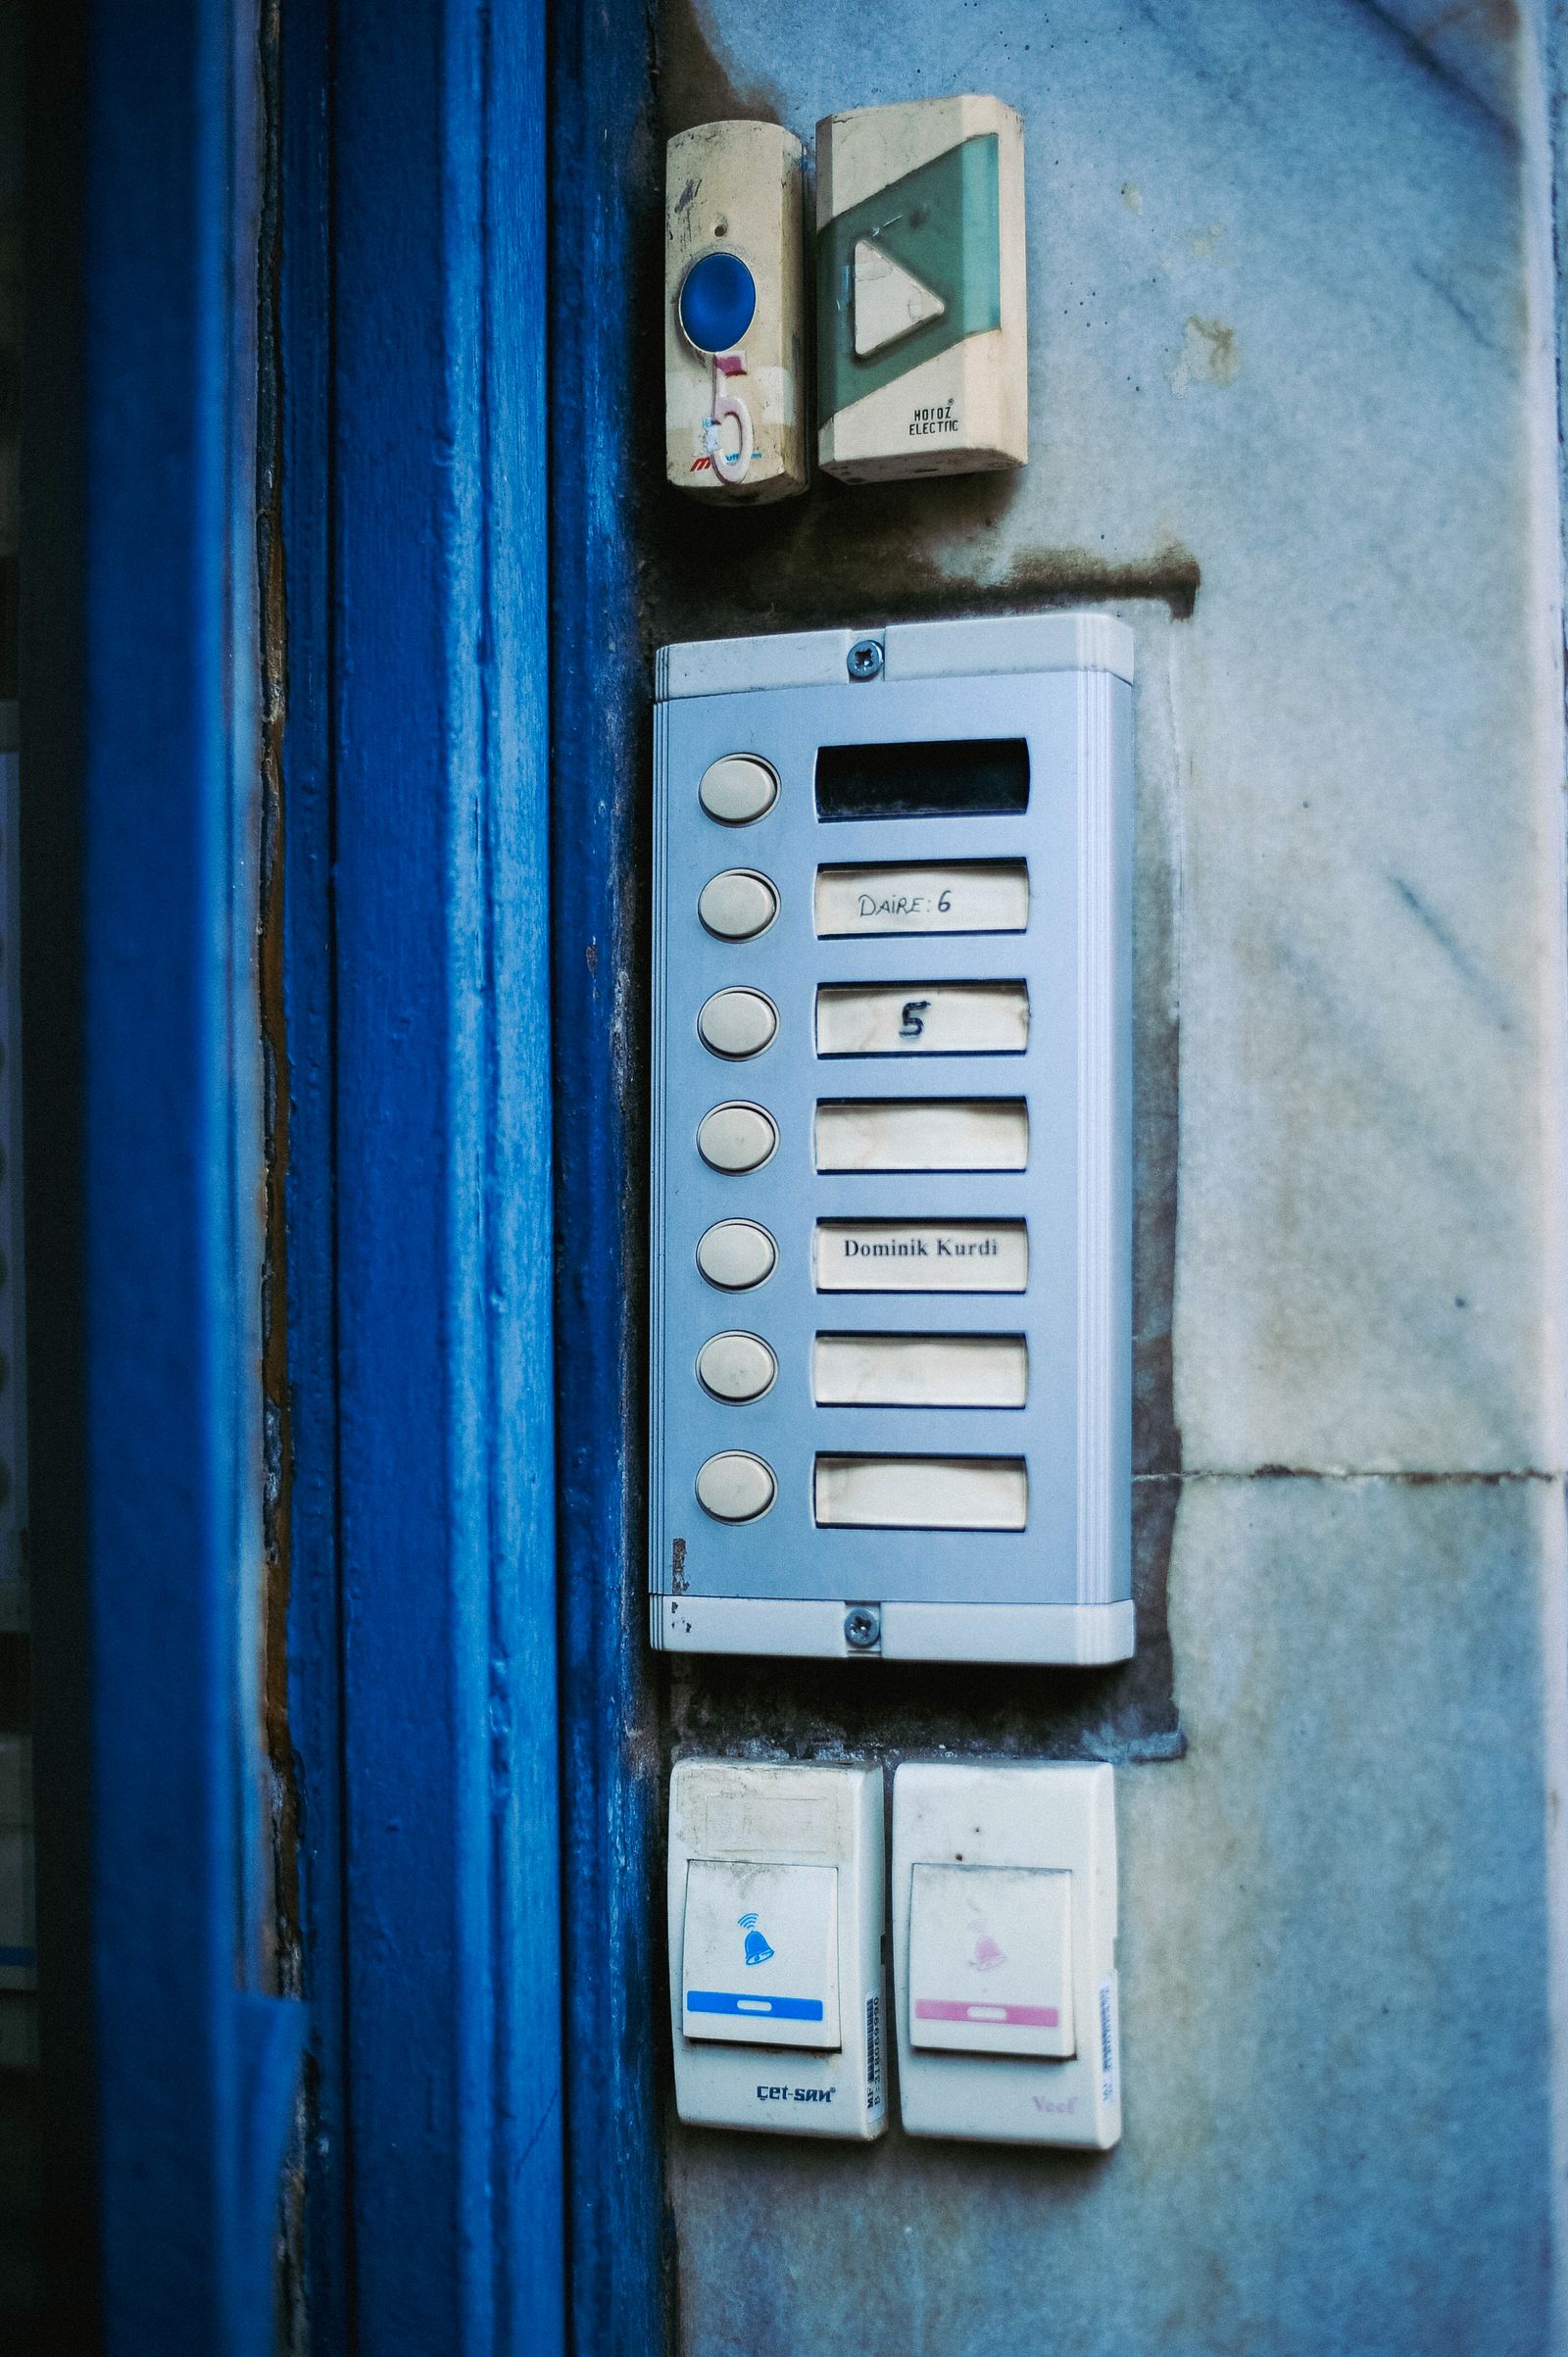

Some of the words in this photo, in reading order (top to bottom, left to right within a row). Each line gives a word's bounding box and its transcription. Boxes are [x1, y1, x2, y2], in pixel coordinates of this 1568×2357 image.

[937, 889, 952, 913] 6
[899, 1000, 931, 1037] 5
[844, 1238, 929, 1257] Dominik
[936, 1238, 999, 1257] Kurdi
